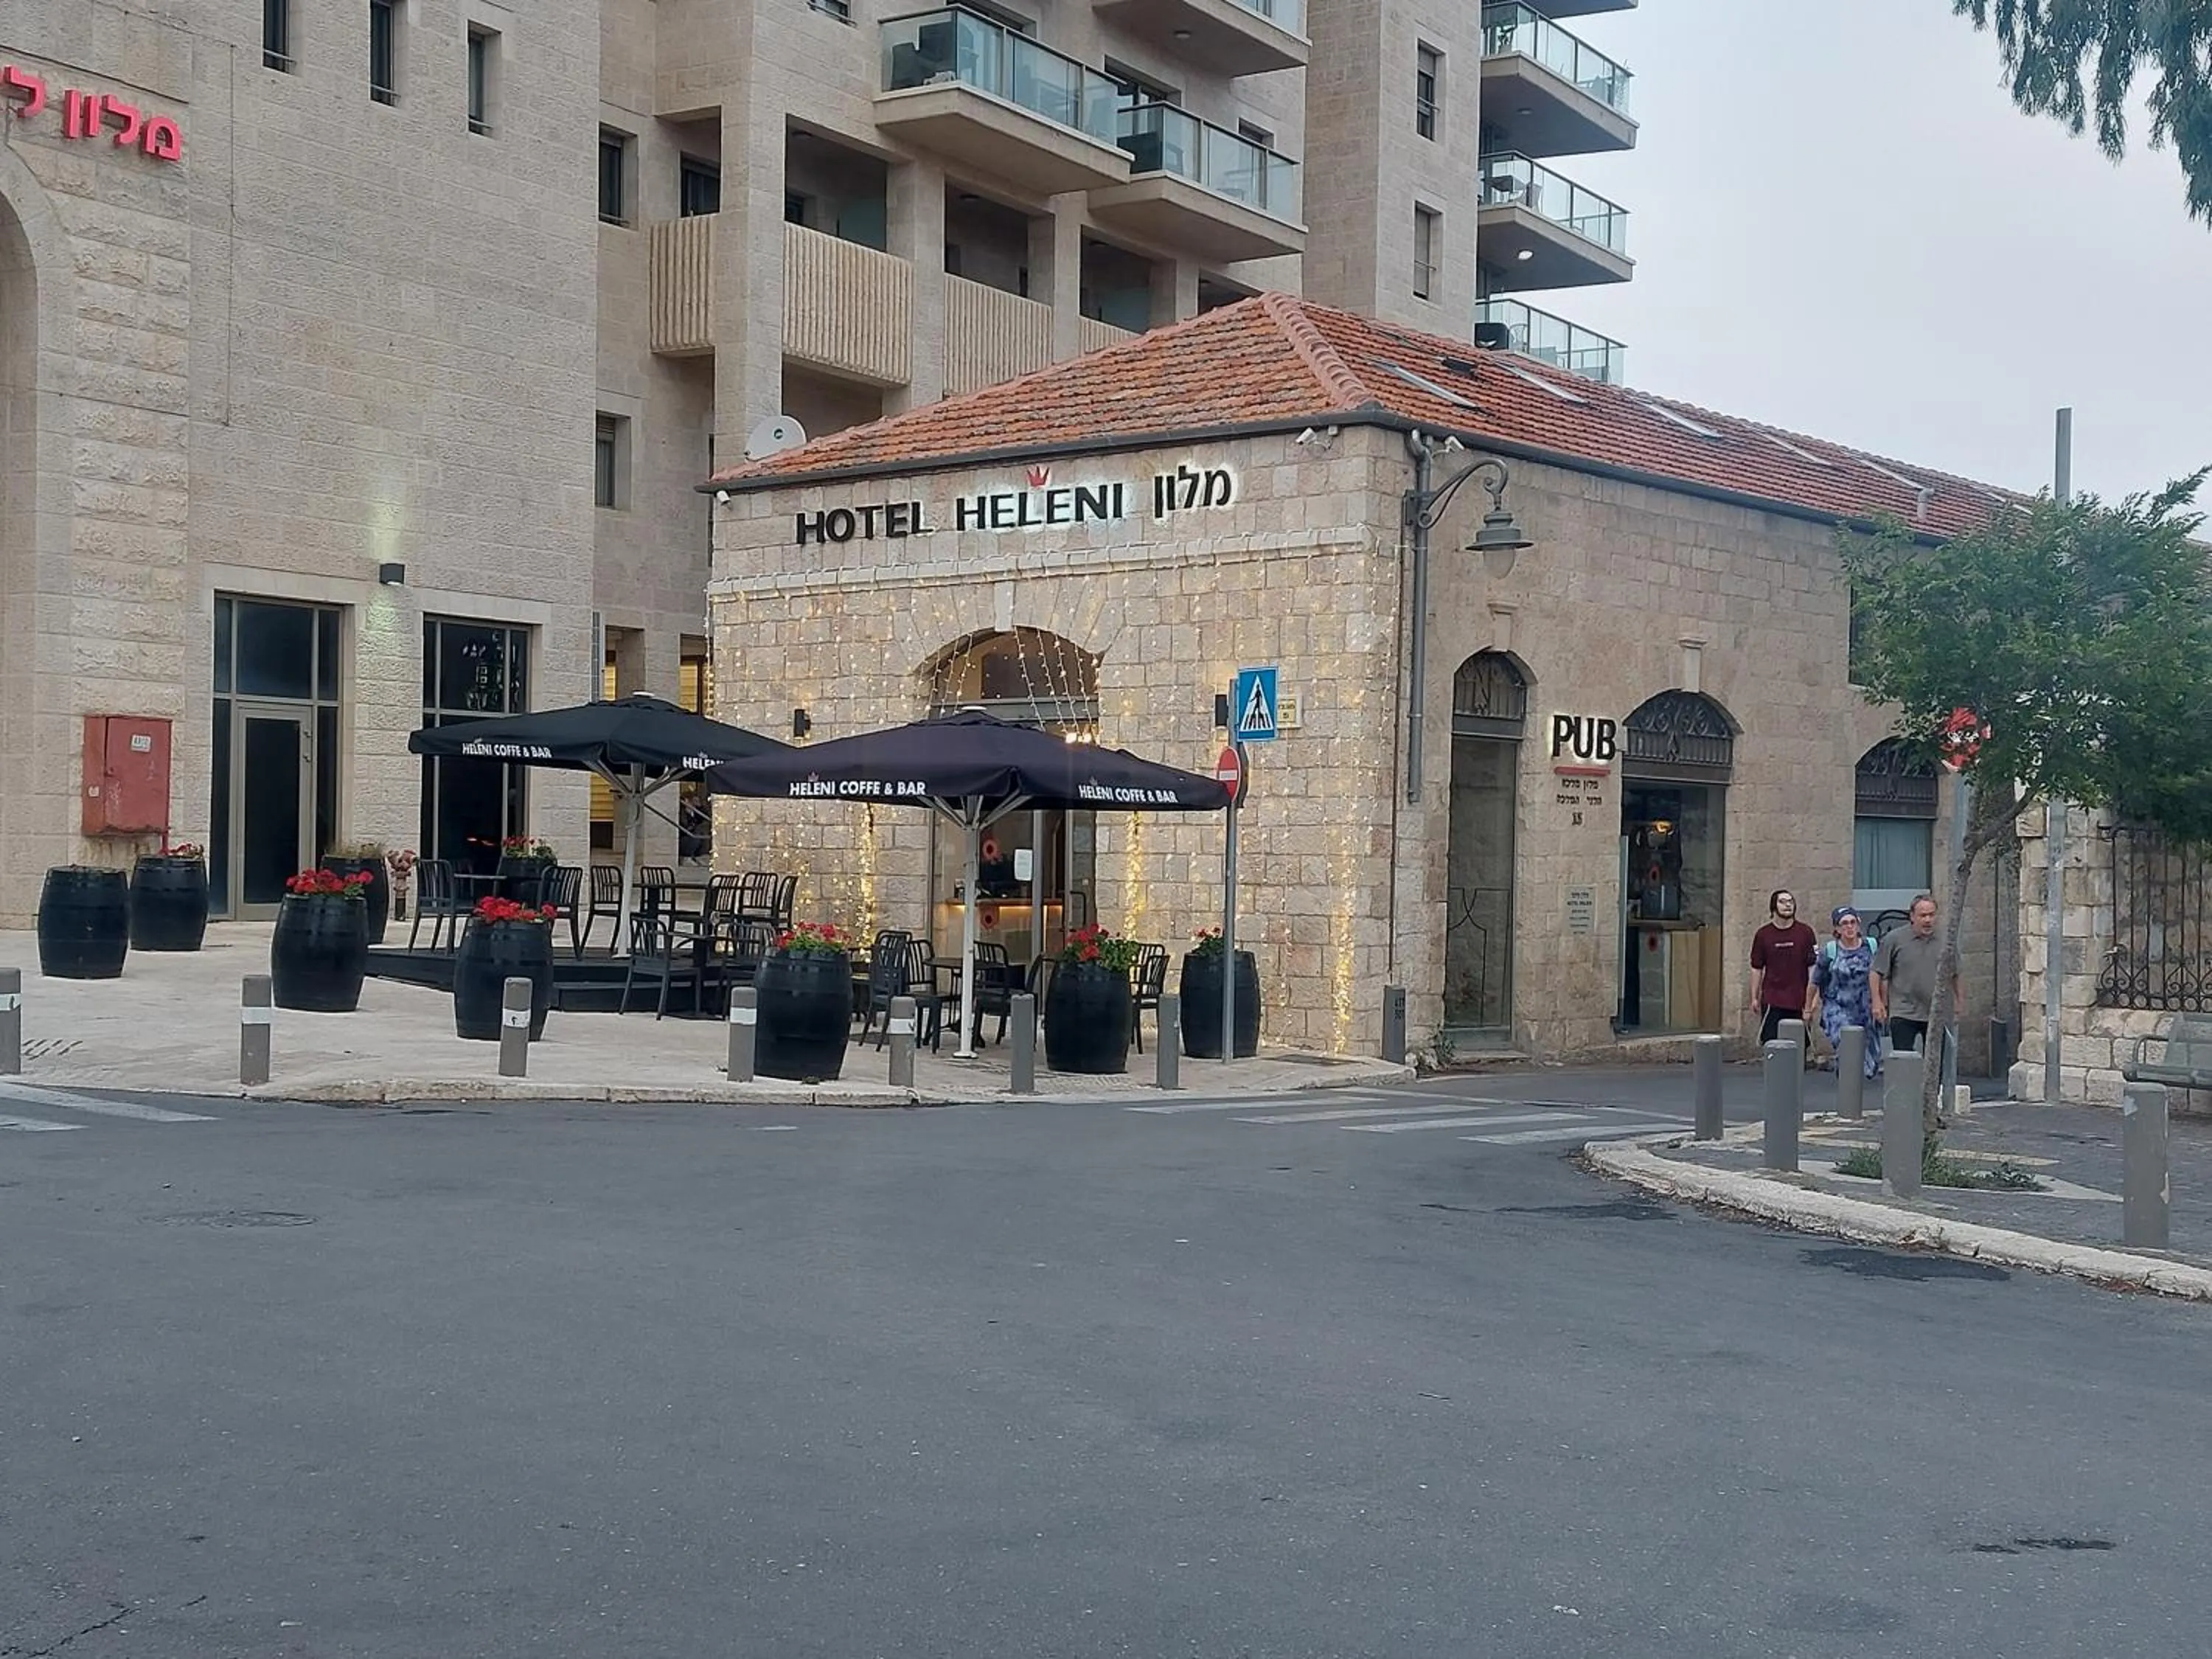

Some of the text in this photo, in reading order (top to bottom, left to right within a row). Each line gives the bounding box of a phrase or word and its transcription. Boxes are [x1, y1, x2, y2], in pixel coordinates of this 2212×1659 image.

[0, 64, 183, 161] מלון ל
[796, 483, 1123, 544] HOTEL HELENI
[1155, 465, 1233, 518] מלון
[462, 742, 552, 759] HELENI COFFE & BAR
[1552, 714, 1617, 760] PUB
[790, 781, 926, 796] HELENI COFFE & BAR
[1078, 784, 1179, 803] HELENI COFFE & BAR
